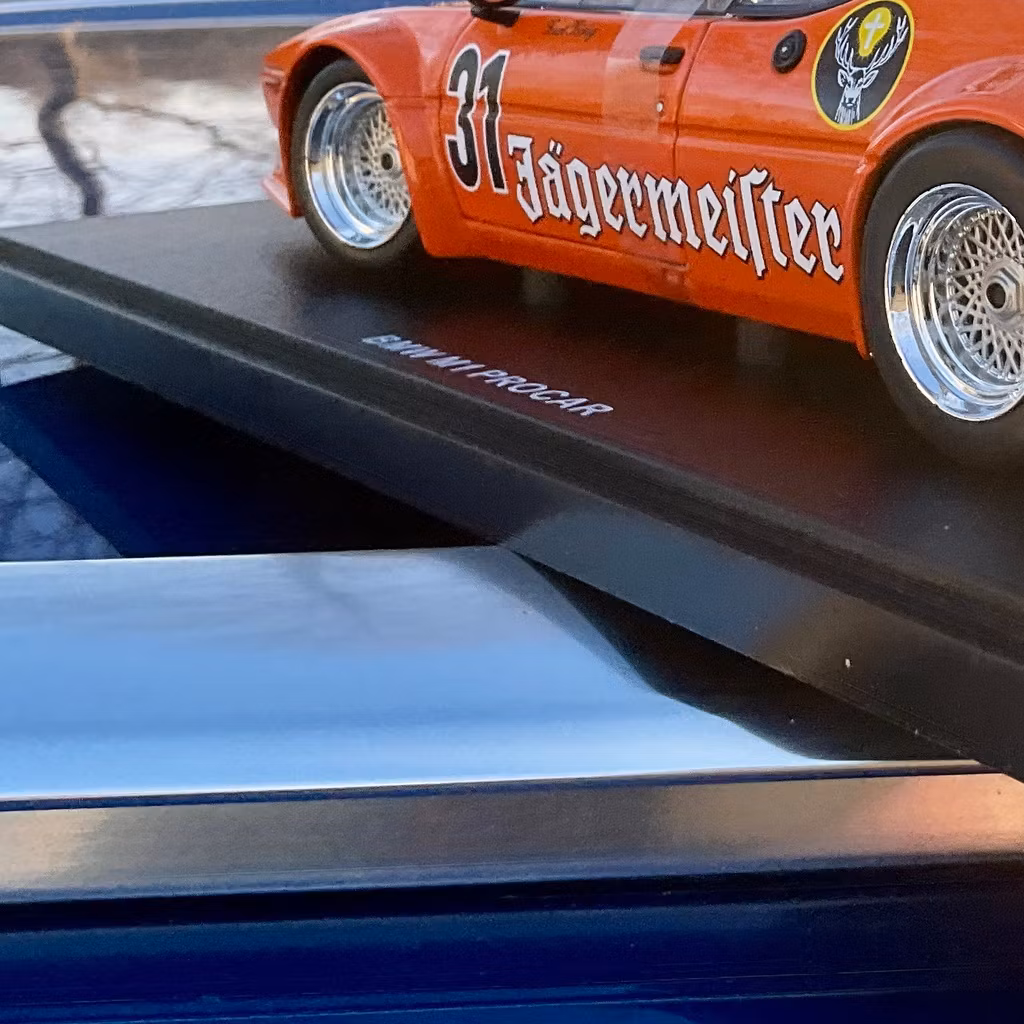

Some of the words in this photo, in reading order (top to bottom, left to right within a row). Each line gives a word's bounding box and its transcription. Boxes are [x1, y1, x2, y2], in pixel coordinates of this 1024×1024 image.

[445, 42, 511, 195] 31
[361, 333, 449, 359] BMW
[465, 368, 615, 417] PROCAR
